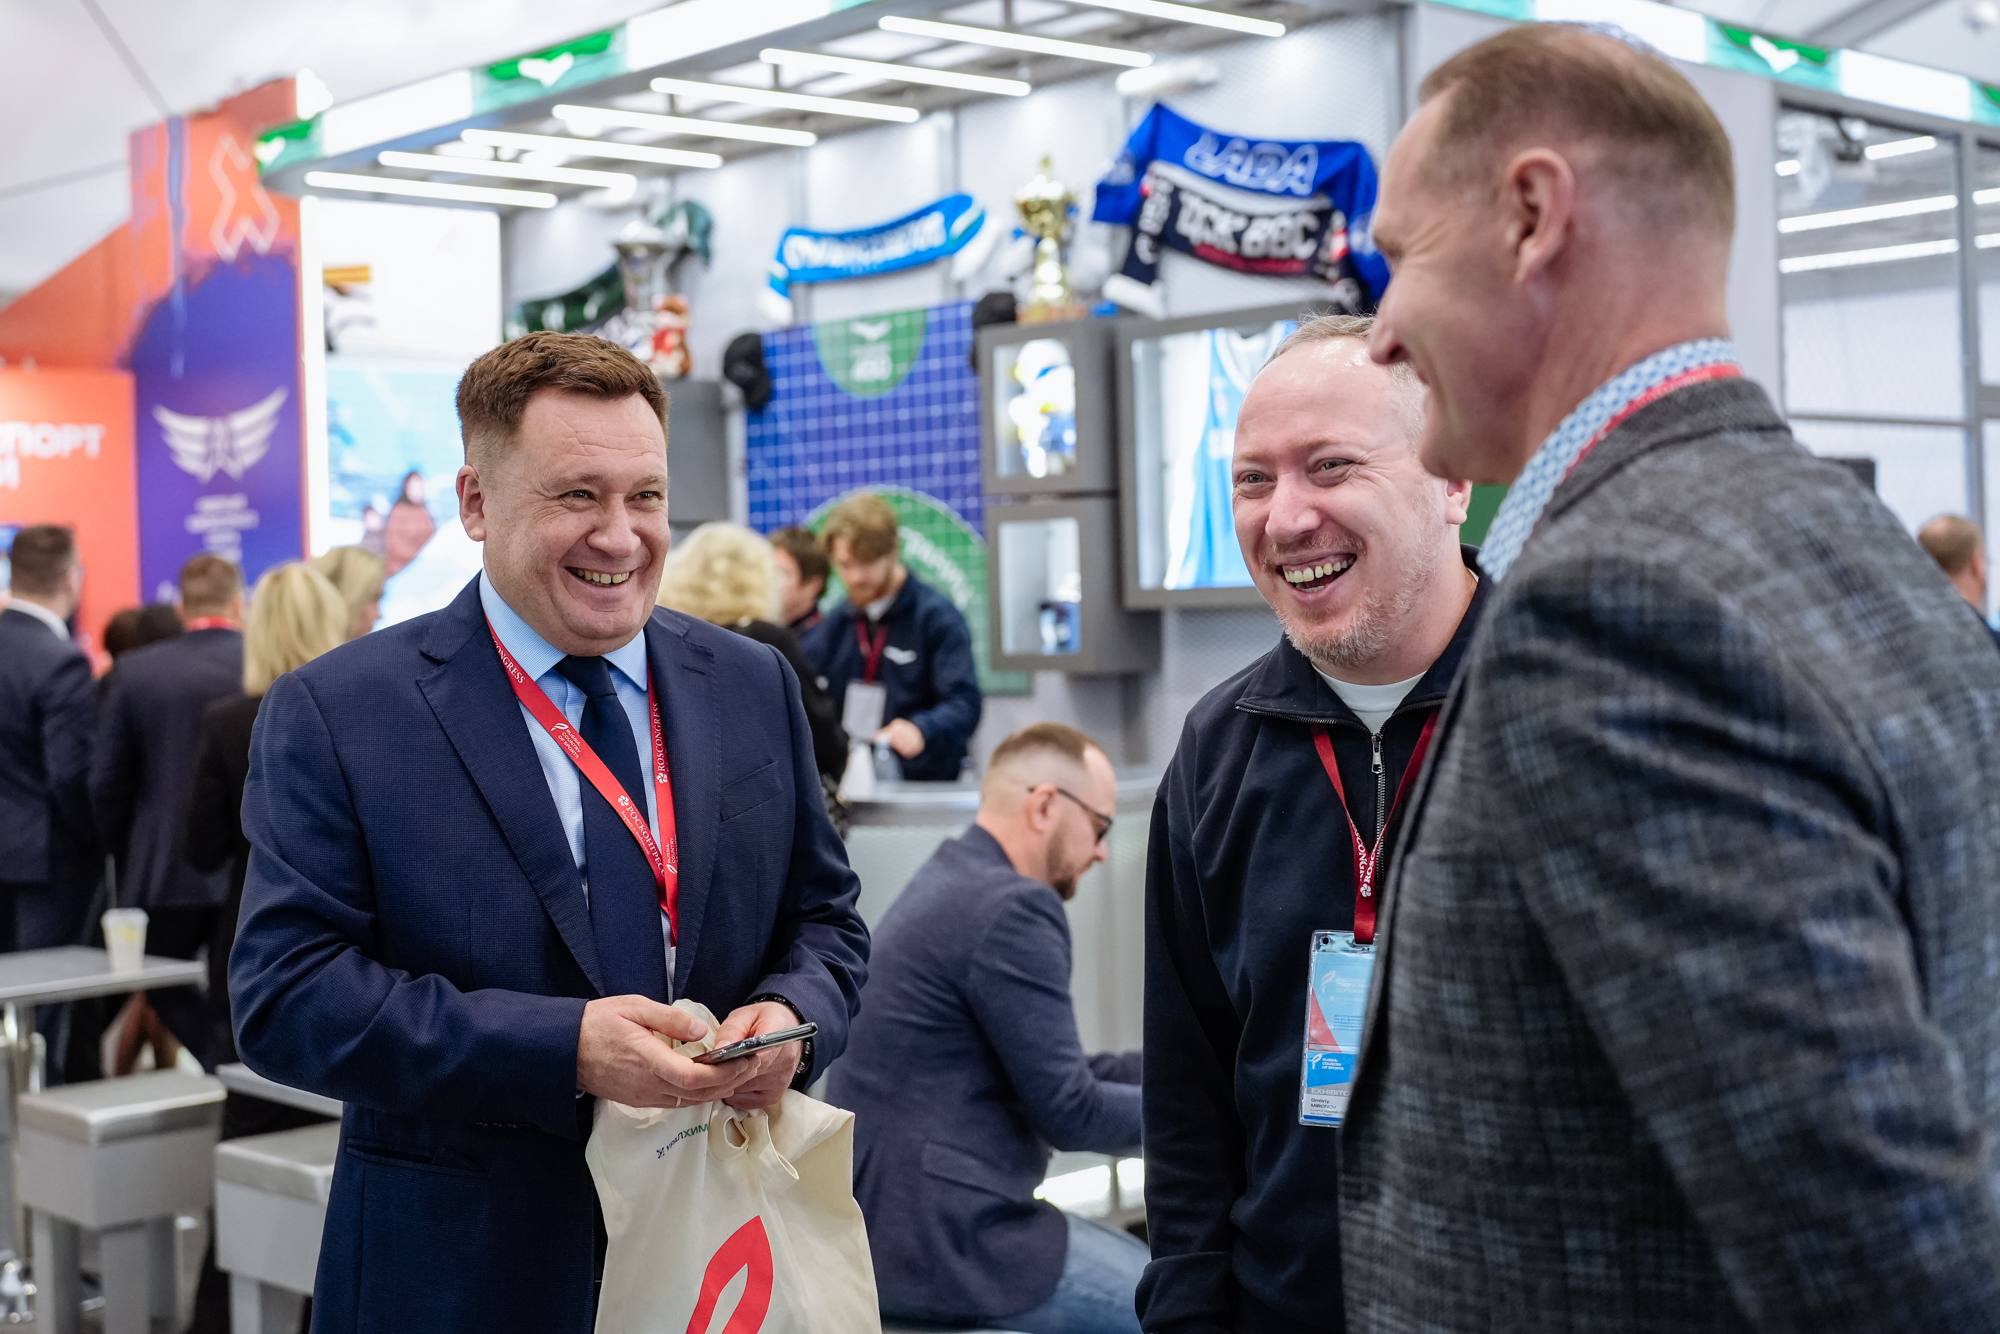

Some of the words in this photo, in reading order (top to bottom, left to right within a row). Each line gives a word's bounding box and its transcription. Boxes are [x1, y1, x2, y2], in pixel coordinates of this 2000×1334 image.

[557, 735, 565, 743] OF
[563, 741, 580, 759] SPORTS
[561, 732, 581, 753] COUNTRY
[1312, 1088, 1351, 1097] EXHIBITO
